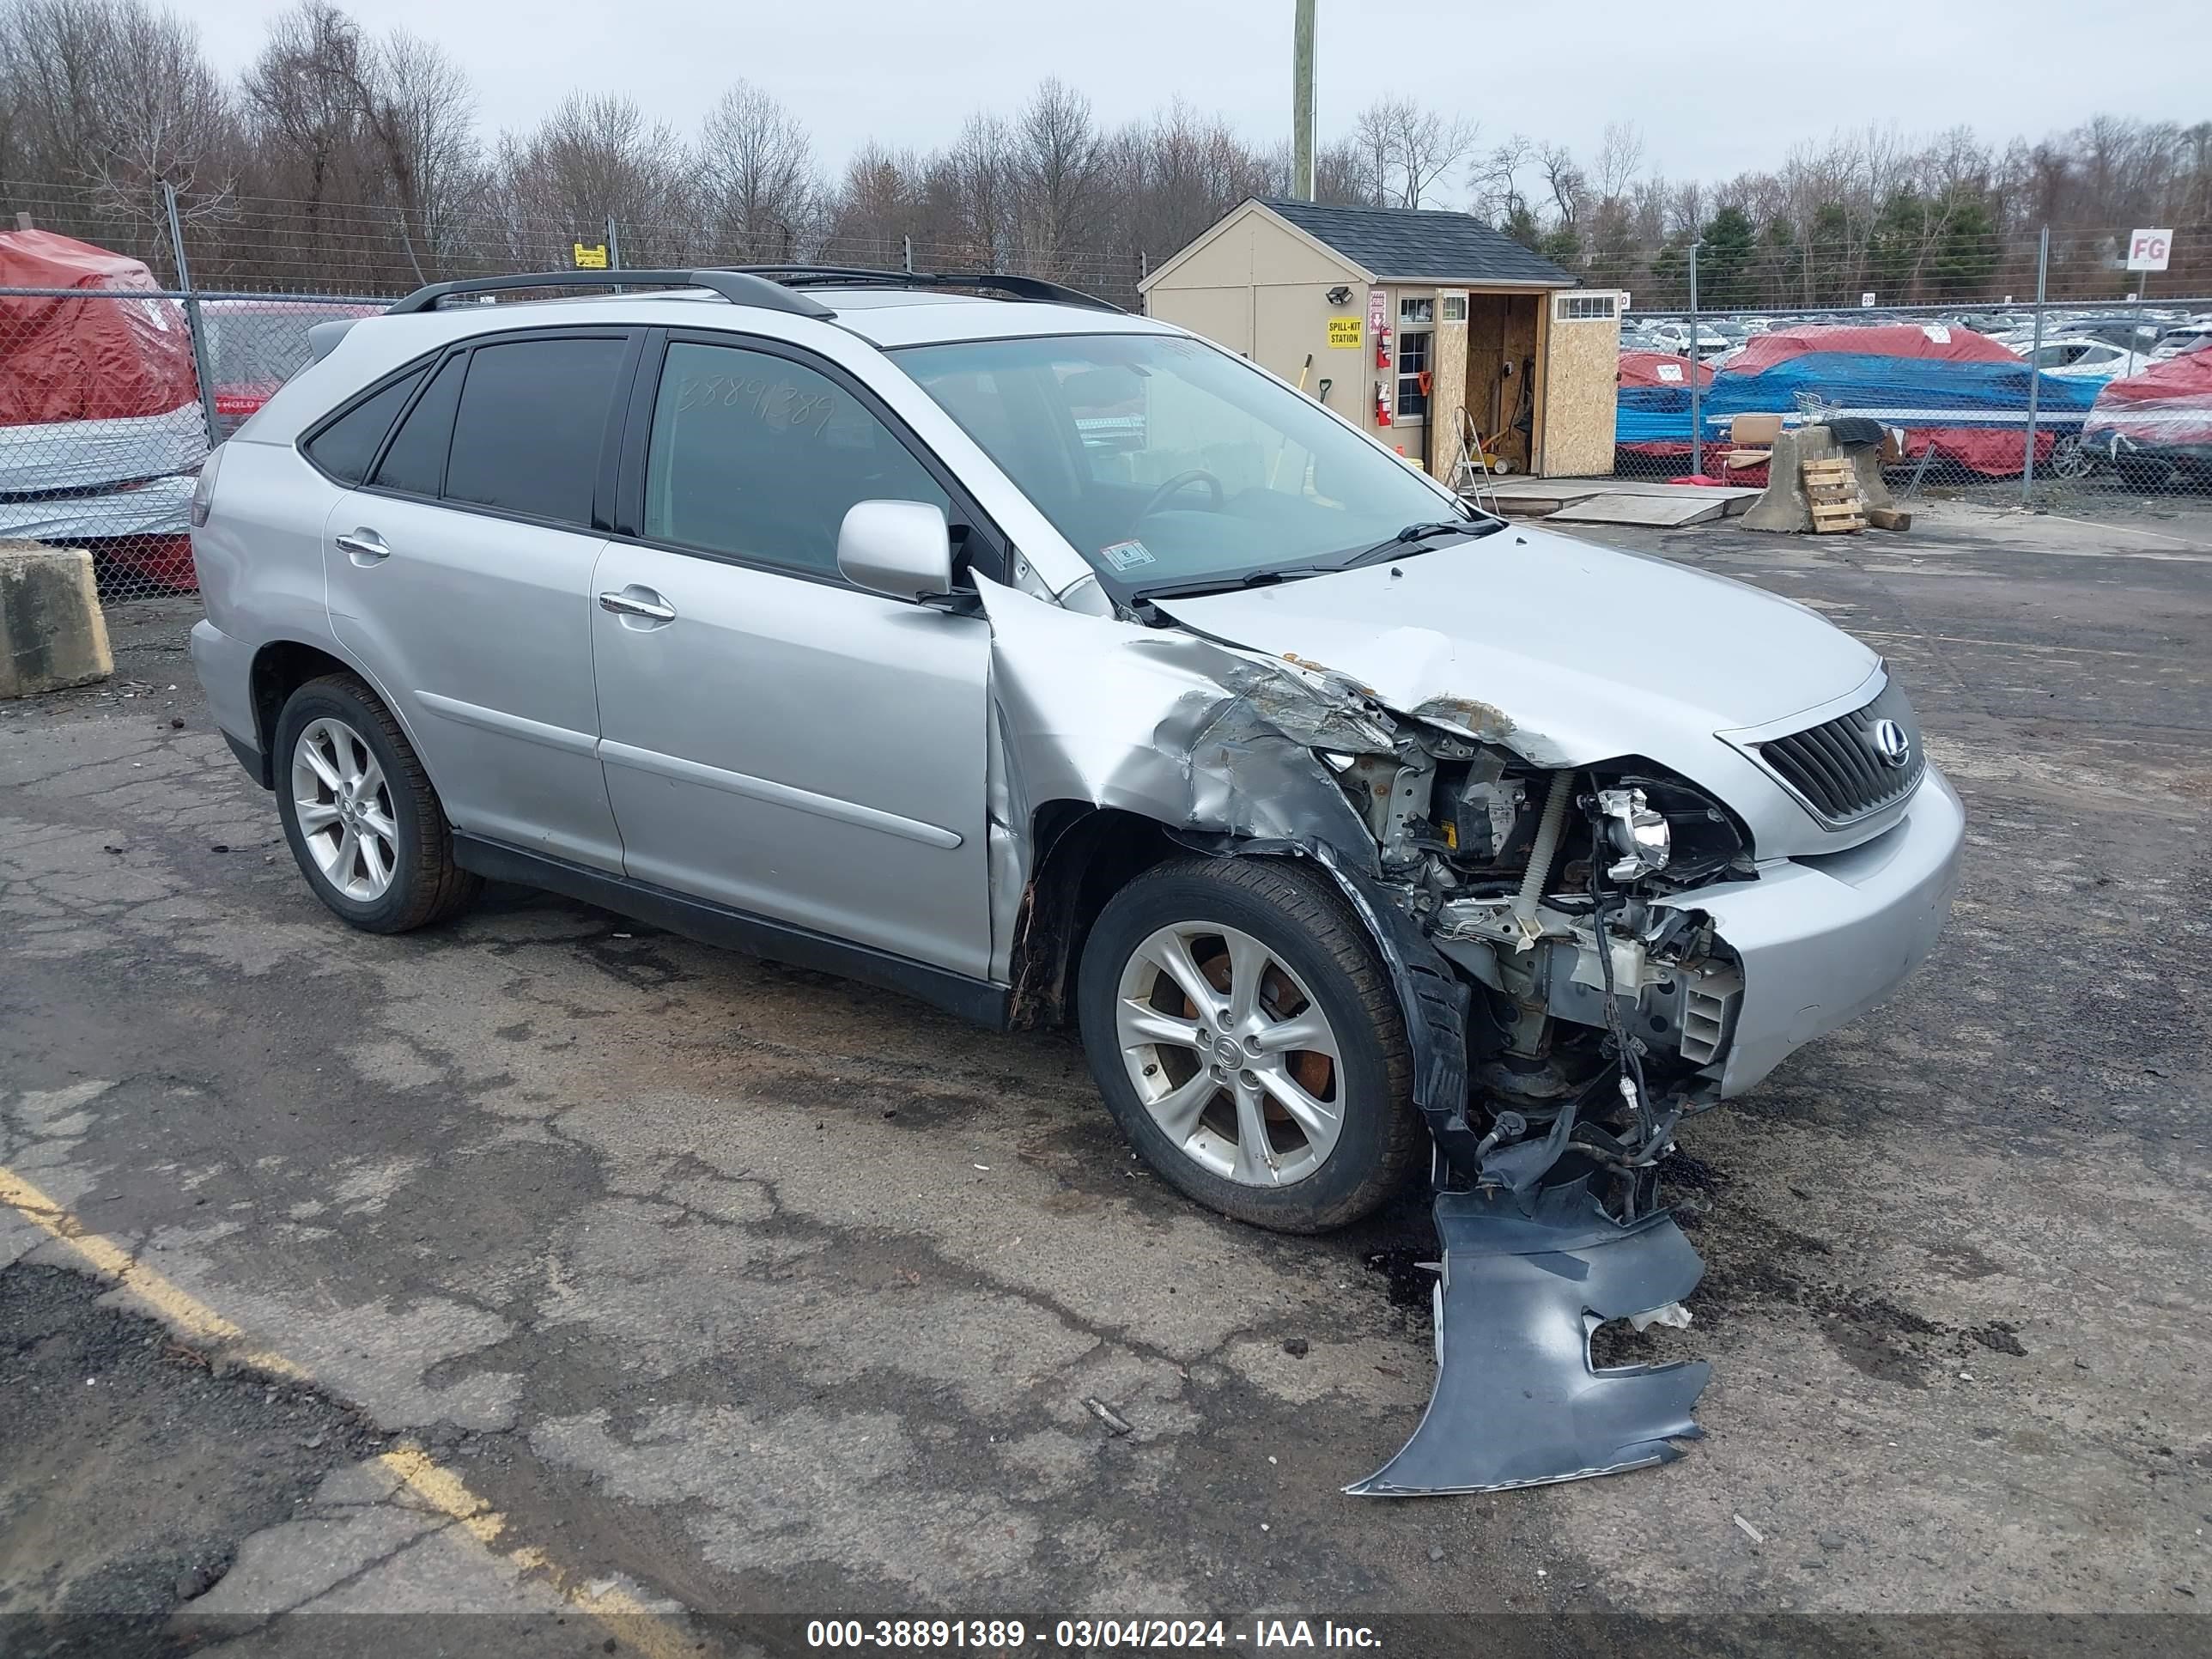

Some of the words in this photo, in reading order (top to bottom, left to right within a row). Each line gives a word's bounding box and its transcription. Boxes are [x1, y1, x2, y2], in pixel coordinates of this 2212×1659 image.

[2134, 238, 2166, 259] FG
[1328, 322, 1361, 331] SPILL-KIT
[1331, 334, 1358, 343] STATION
[679, 374, 836, 440] 38891389
[1121, 550, 1131, 558] 8
